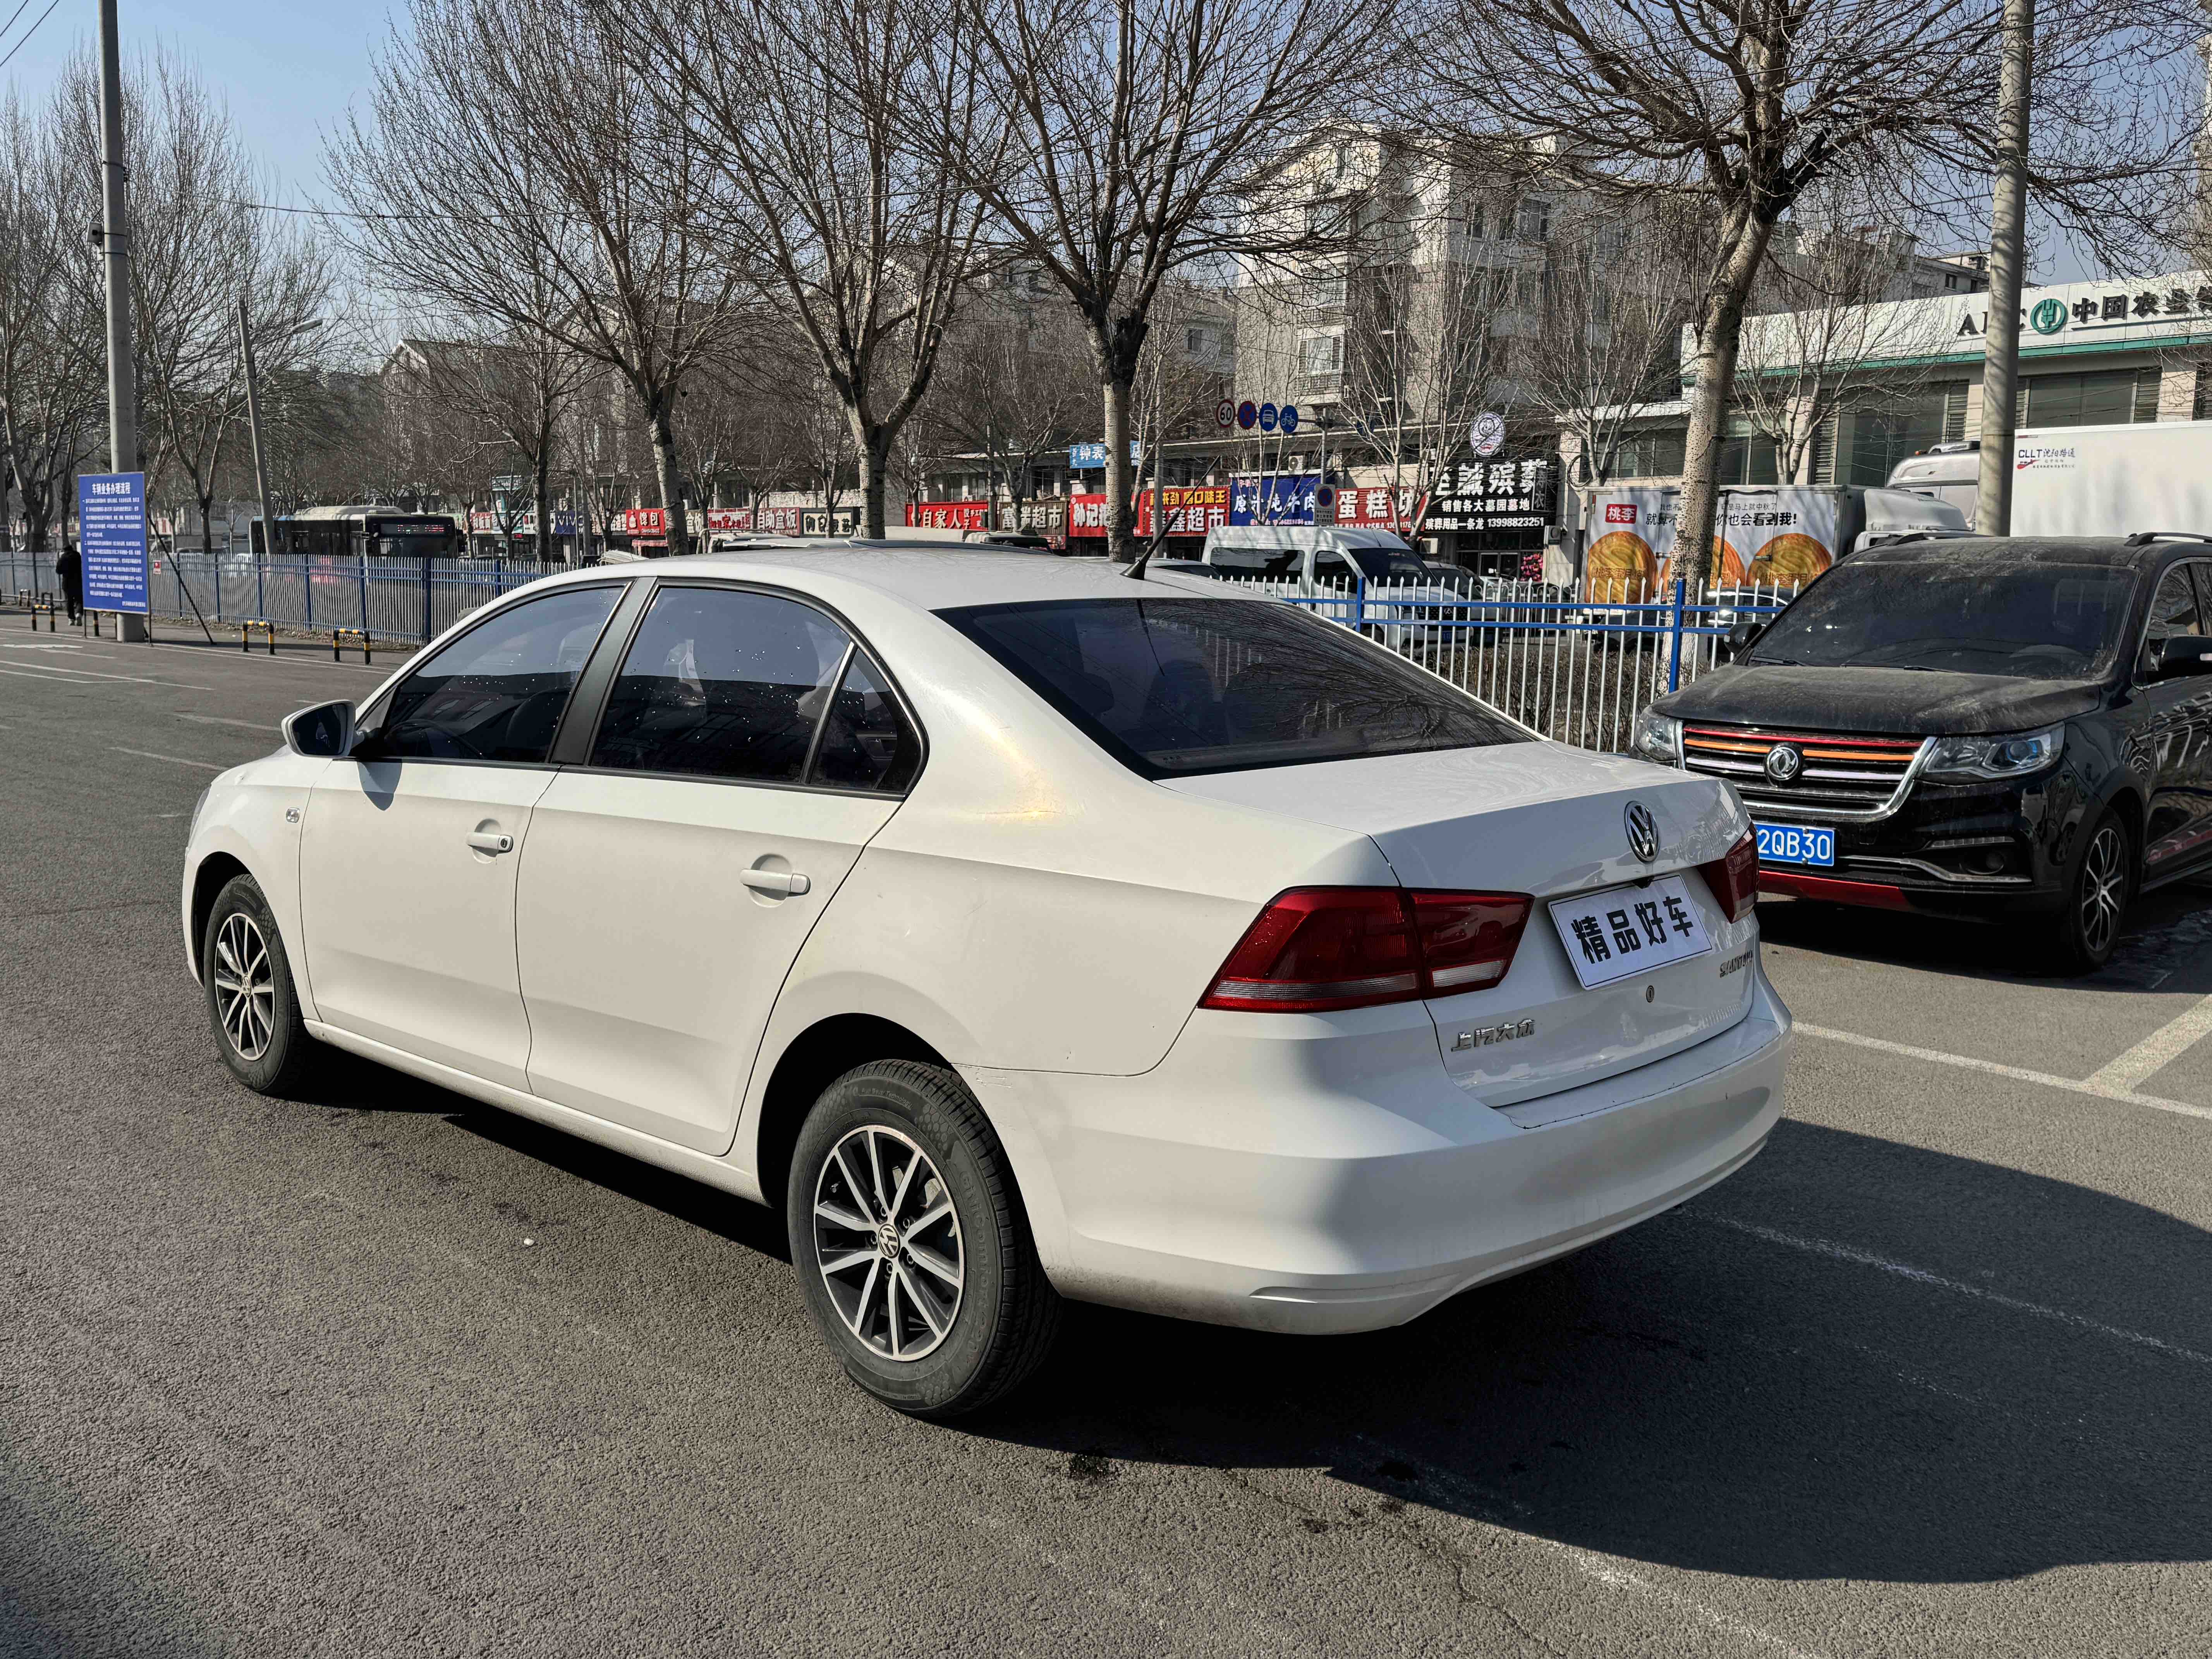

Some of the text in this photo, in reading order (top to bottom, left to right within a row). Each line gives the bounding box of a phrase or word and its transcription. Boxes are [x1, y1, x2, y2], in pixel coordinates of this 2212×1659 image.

[1220, 407, 1231, 421] 60
[2018, 449, 2042, 458] CLLT
[1442, 498, 1530, 512] 销售各大墓园墓地
[1608, 506, 1635, 521] 桃李
[757, 509, 797, 529] 自助盒饭
[923, 508, 962, 529] 自家人
[1487, 517, 1544, 527] 13998823251
[1758, 829, 1831, 860] 2QB30
[1571, 896, 1694, 964] 精品好车
[1451, 1018, 1535, 1052] 上汽大众
